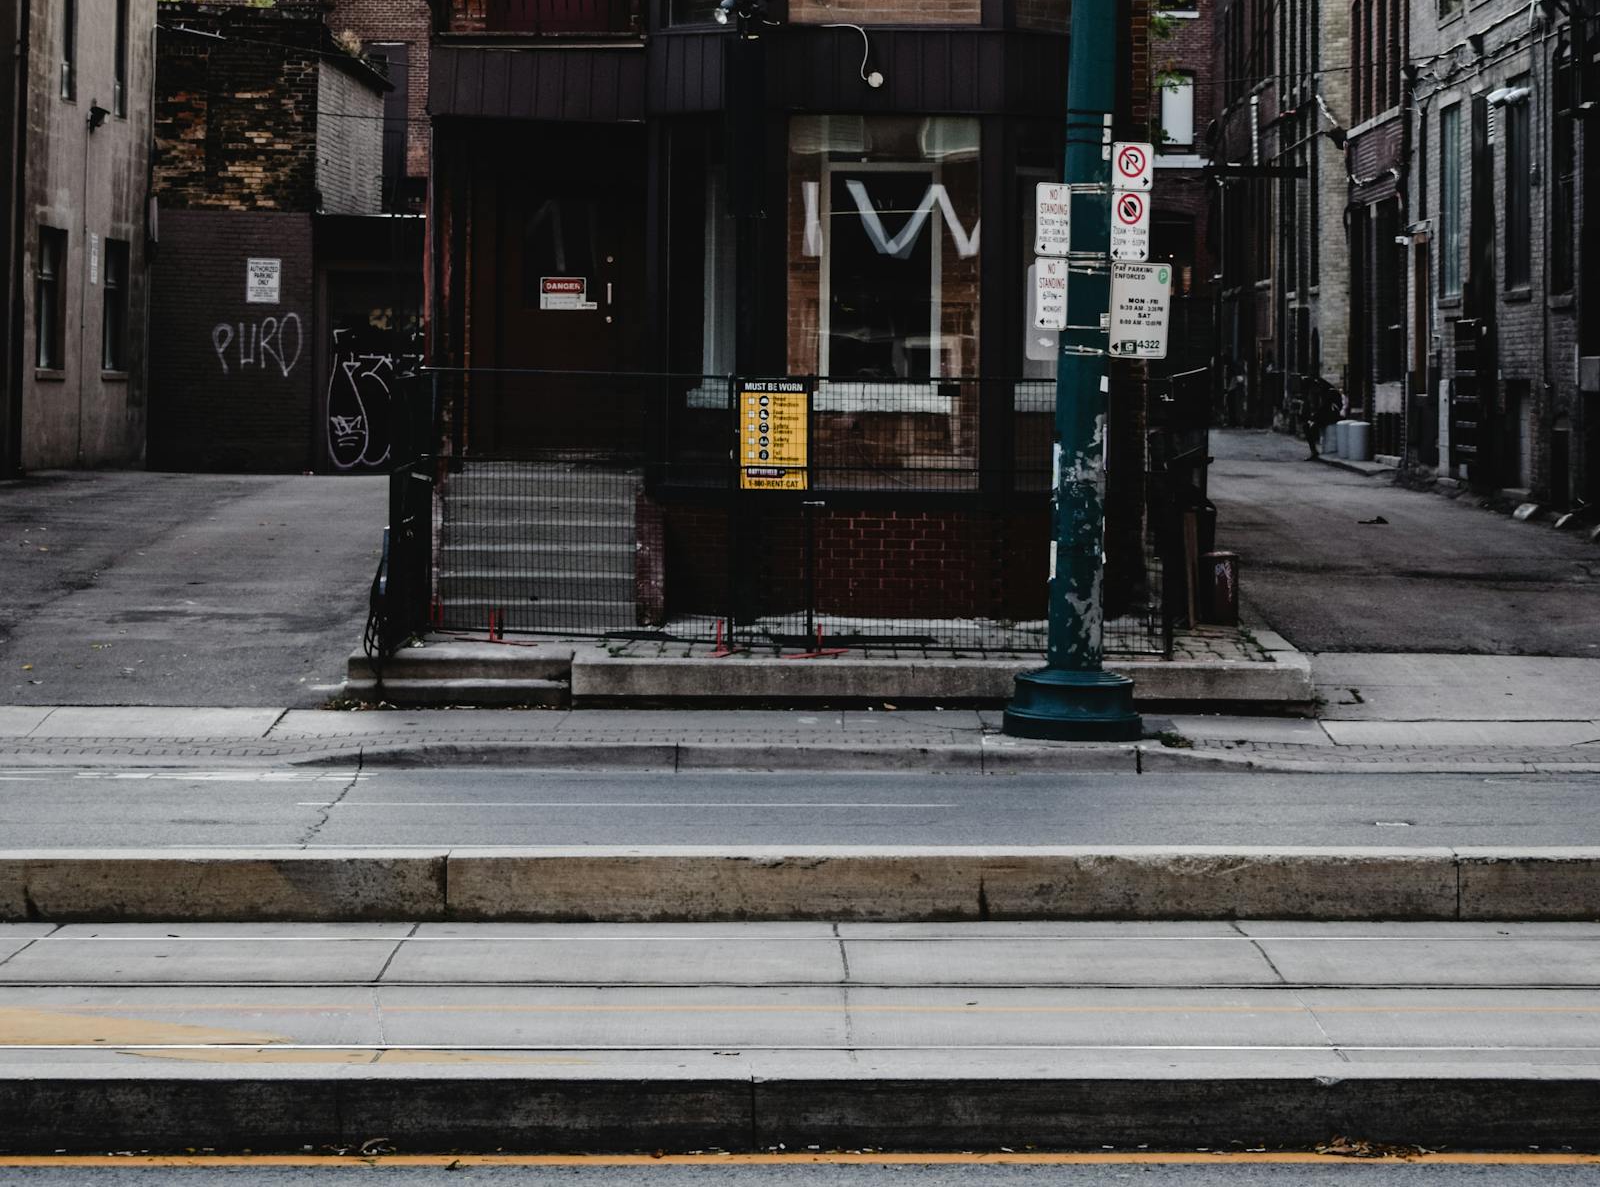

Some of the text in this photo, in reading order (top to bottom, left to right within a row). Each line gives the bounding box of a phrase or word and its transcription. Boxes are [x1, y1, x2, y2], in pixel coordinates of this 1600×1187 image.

[1049, 189, 1058, 200] NO
[1040, 203, 1068, 215] STANDING
[1048, 263, 1056, 274] NO
[1128, 266, 1153, 274] PARKING
[1115, 272, 1146, 280] ENFORCED
[1039, 277, 1065, 289] STANDING
[1137, 340, 1160, 349] 4322
[745, 382, 803, 391] MUST BE WORN
